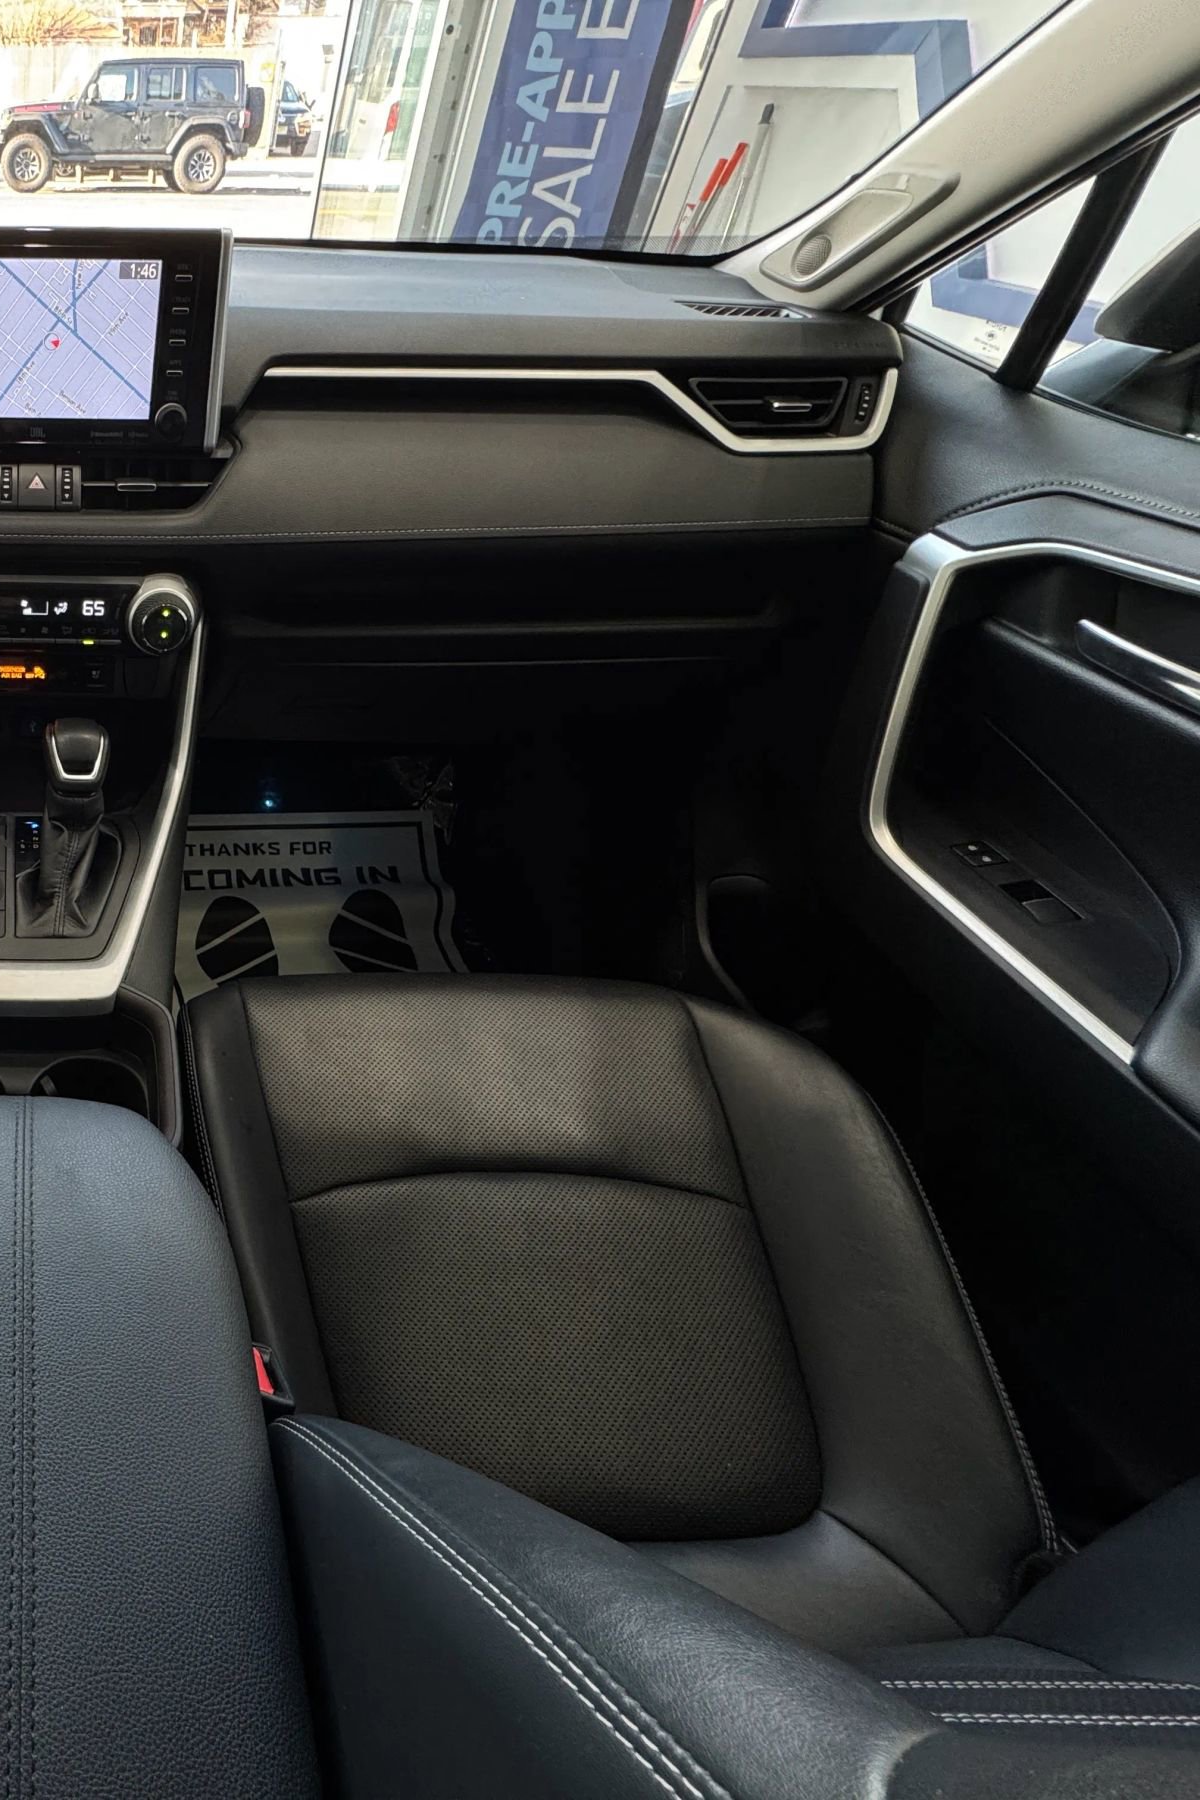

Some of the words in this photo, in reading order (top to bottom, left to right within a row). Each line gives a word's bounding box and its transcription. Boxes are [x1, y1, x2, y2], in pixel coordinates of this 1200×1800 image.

[130, 263, 157, 279] 1:46
[82, 600, 105, 616] 65
[185, 842, 280, 857] THANKS
[290, 840, 332, 855] FOR
[183, 867, 341, 891] COMING
[356, 866, 401, 885] IN
